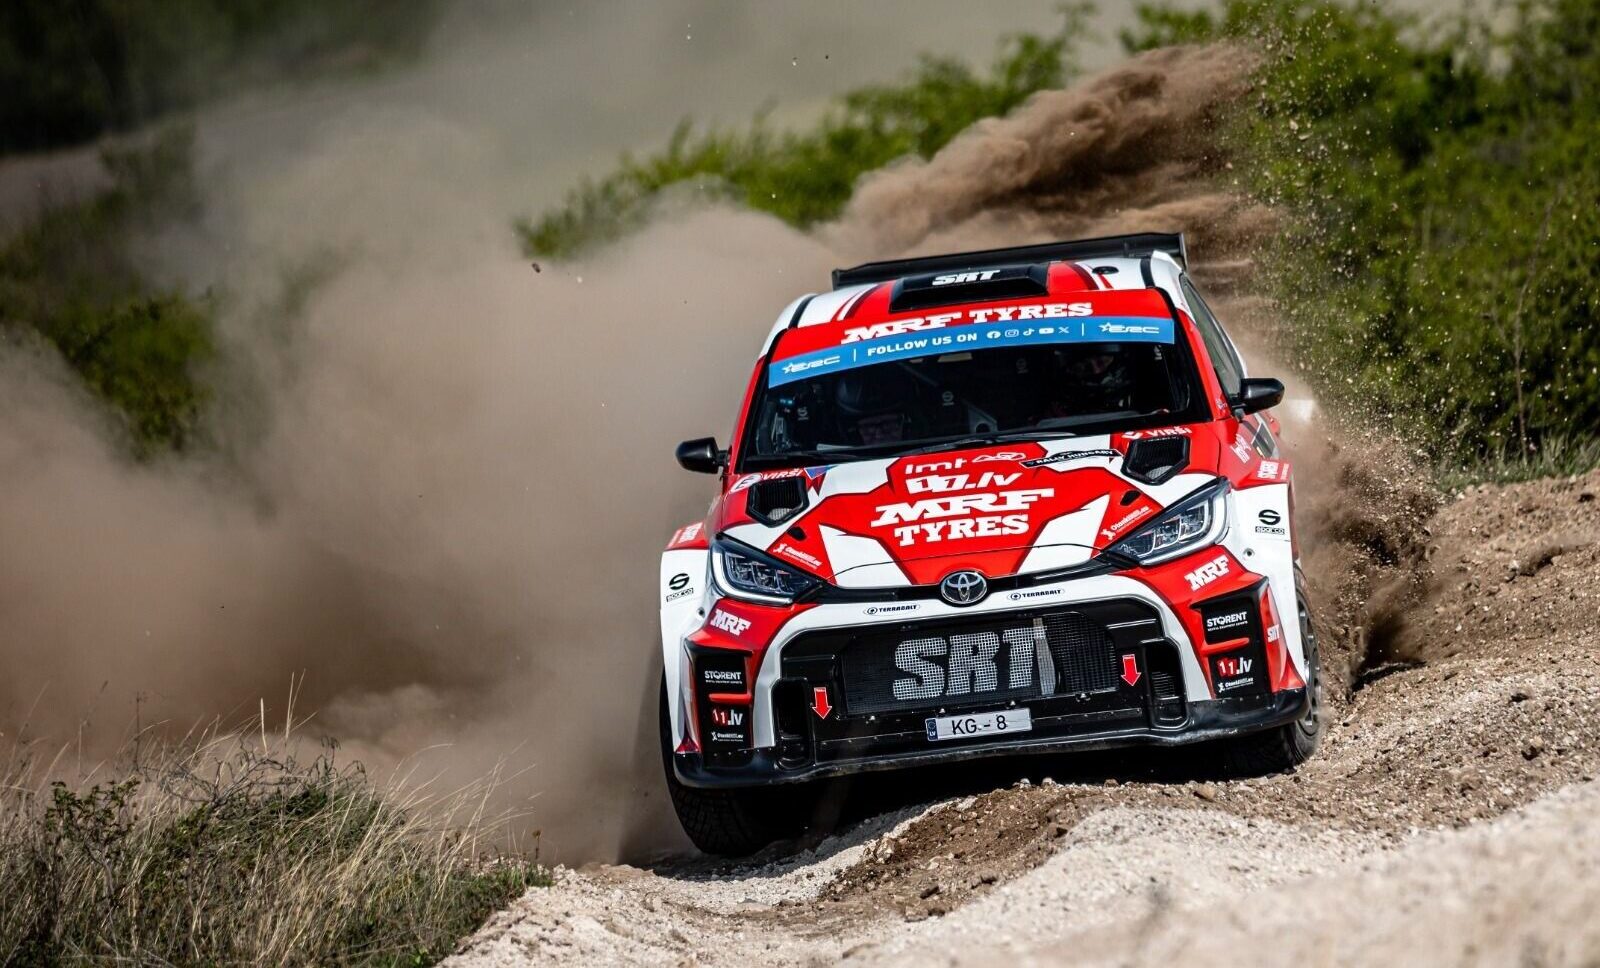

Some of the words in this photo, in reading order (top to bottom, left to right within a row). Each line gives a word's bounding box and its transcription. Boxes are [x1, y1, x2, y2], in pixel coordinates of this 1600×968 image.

[932, 269, 1001, 286] SRT
[840, 309, 962, 345] MRF
[968, 302, 1093, 324] TYRES
[867, 338, 928, 357] FOLLOW
[932, 336, 952, 347] US
[957, 332, 978, 343] ON
[1036, 455, 1065, 464] RALLY
[1067, 450, 1113, 461] HUNGARY
[870, 487, 1055, 527] MRF
[894, 513, 1030, 547] TYRES
[1184, 554, 1230, 592] MRF
[710, 608, 752, 636] MRF
[1206, 611, 1248, 627] STORENT
[704, 670, 742, 680] STORENT
[892, 625, 1048, 701] SRT
[1219, 656, 1253, 675] 11.lv
[712, 708, 744, 726] 11.lv
